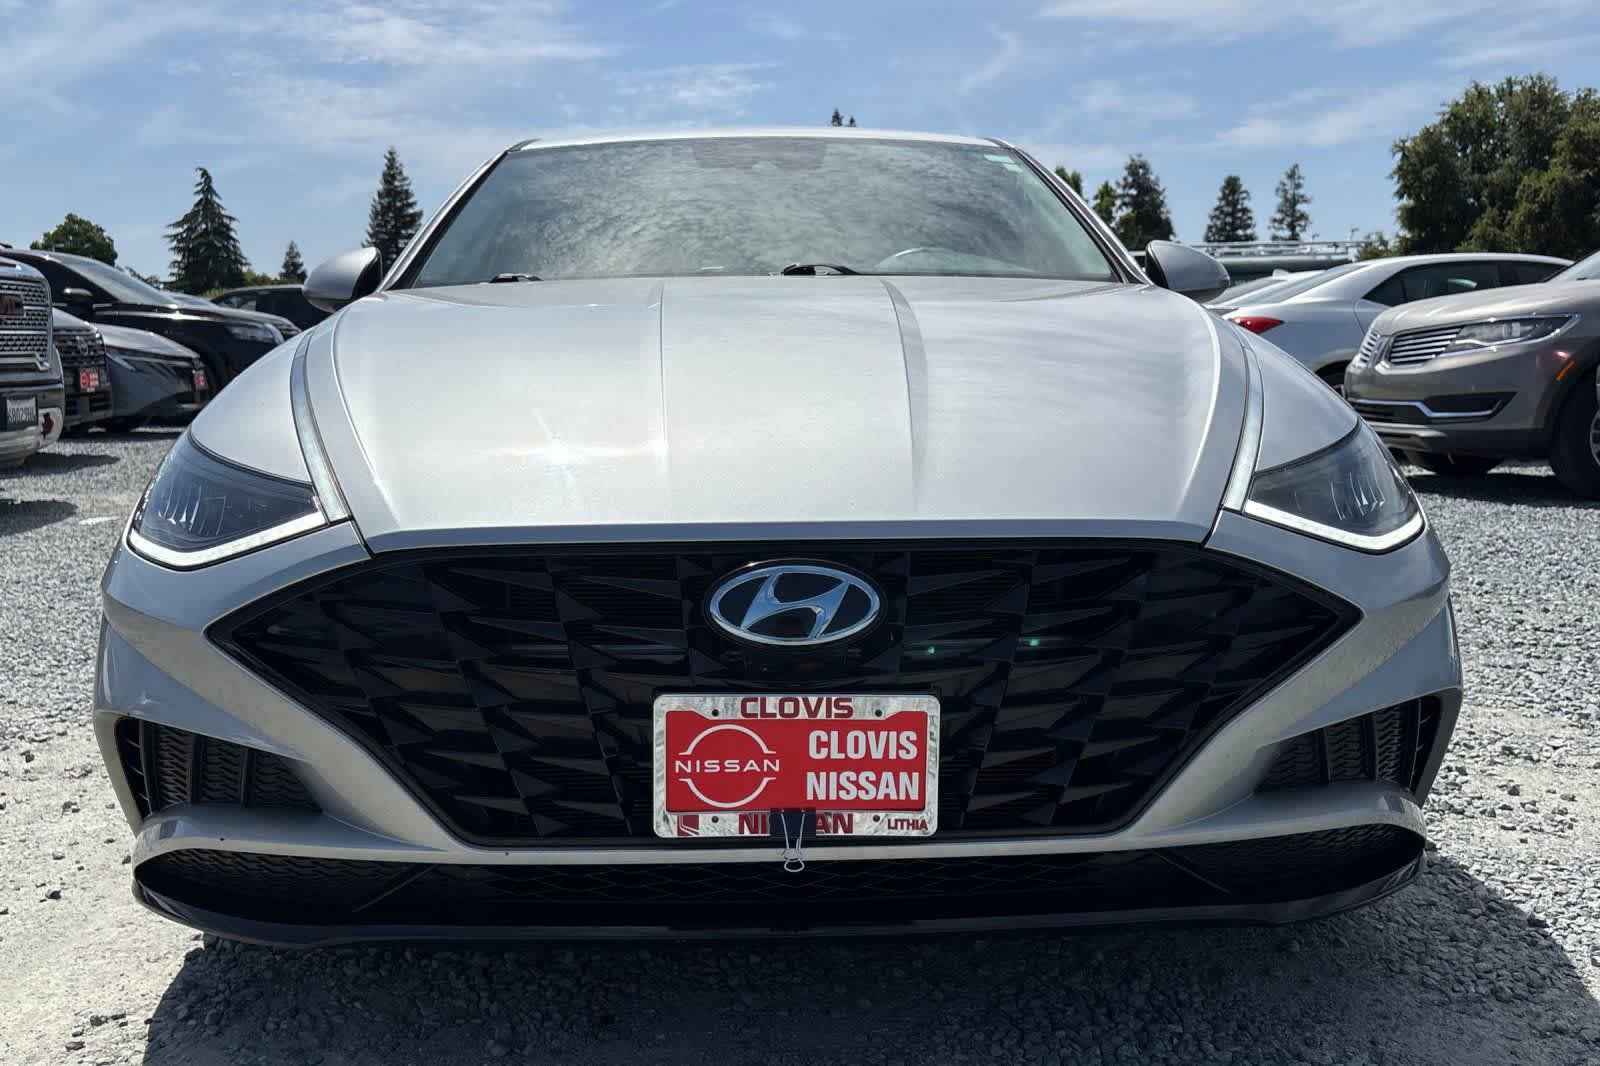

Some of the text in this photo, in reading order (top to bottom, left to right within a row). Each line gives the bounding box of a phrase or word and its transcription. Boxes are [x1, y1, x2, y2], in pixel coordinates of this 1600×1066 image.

[741, 697, 854, 719] CLOVIS
[809, 730, 918, 760] CLOVIS
[675, 759, 780, 773] NISSAN
[806, 771, 920, 801] NISSAN
[738, 813, 855, 835] NIAN
[887, 818, 929, 831] LITHIA
